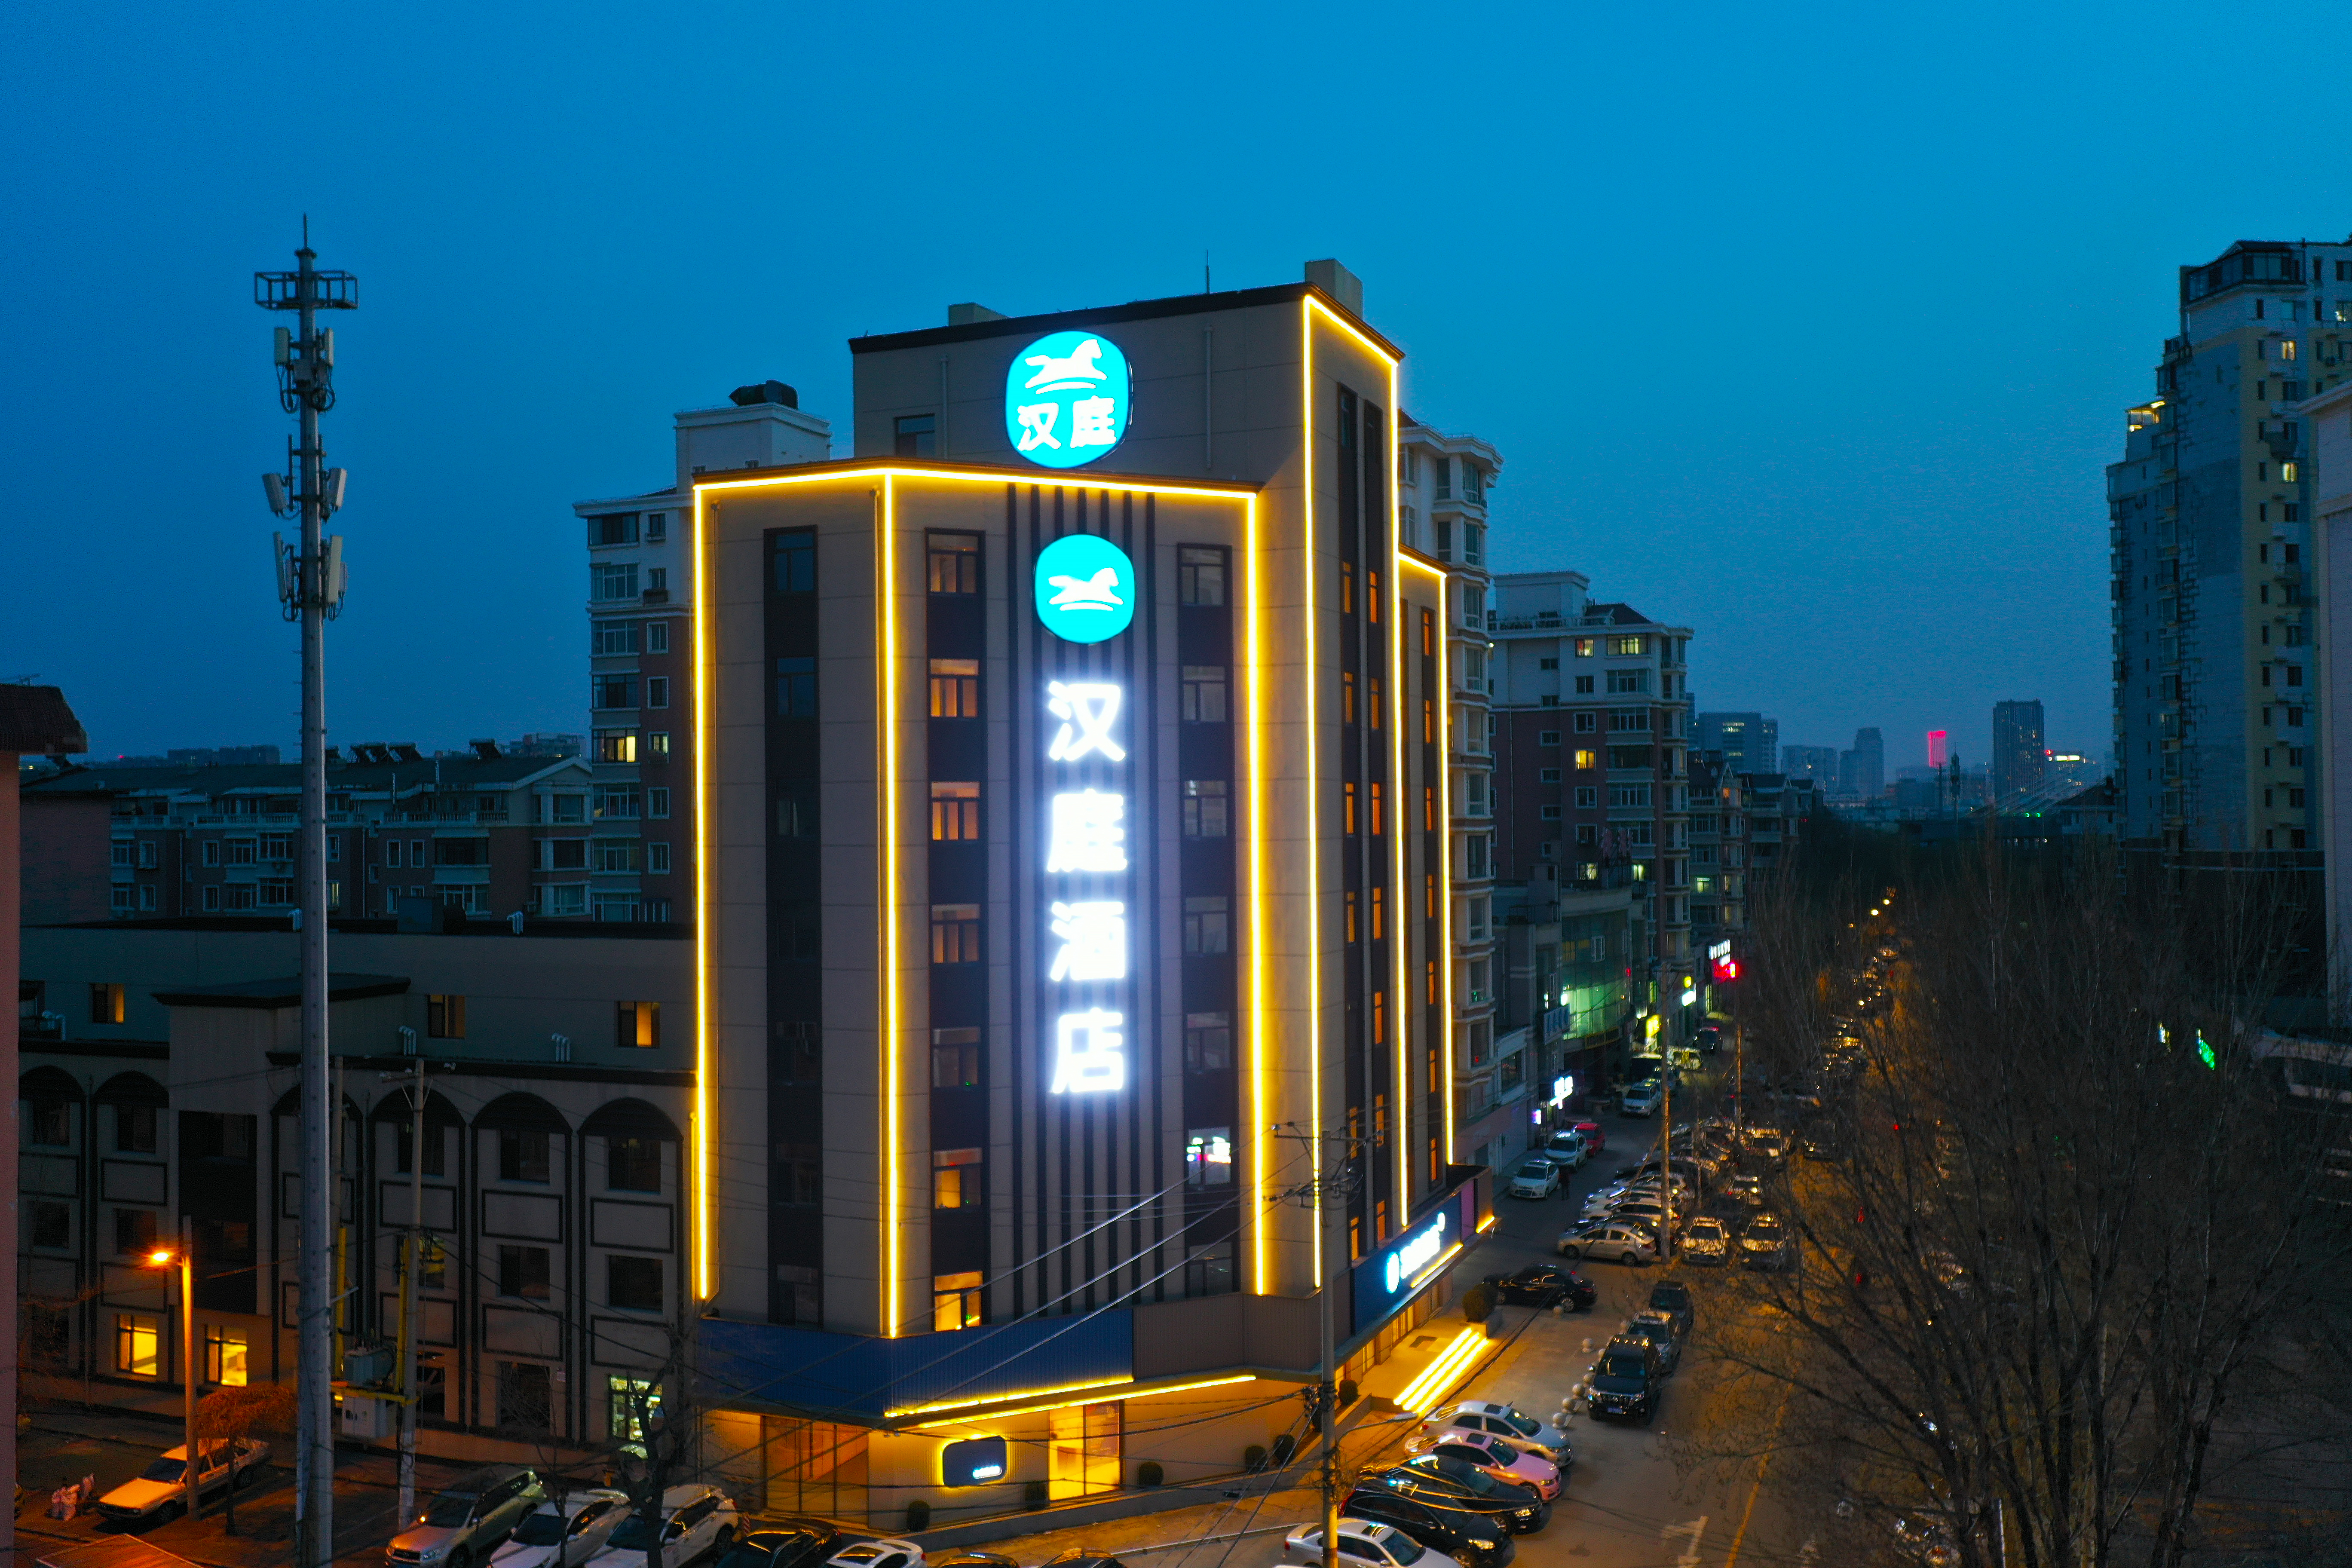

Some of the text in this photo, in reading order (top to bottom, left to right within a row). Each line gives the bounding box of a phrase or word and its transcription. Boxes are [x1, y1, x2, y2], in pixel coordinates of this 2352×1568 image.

[1017, 395, 1117, 451] 汉庭
[1047, 680, 1127, 1094] 汉庭酒店
